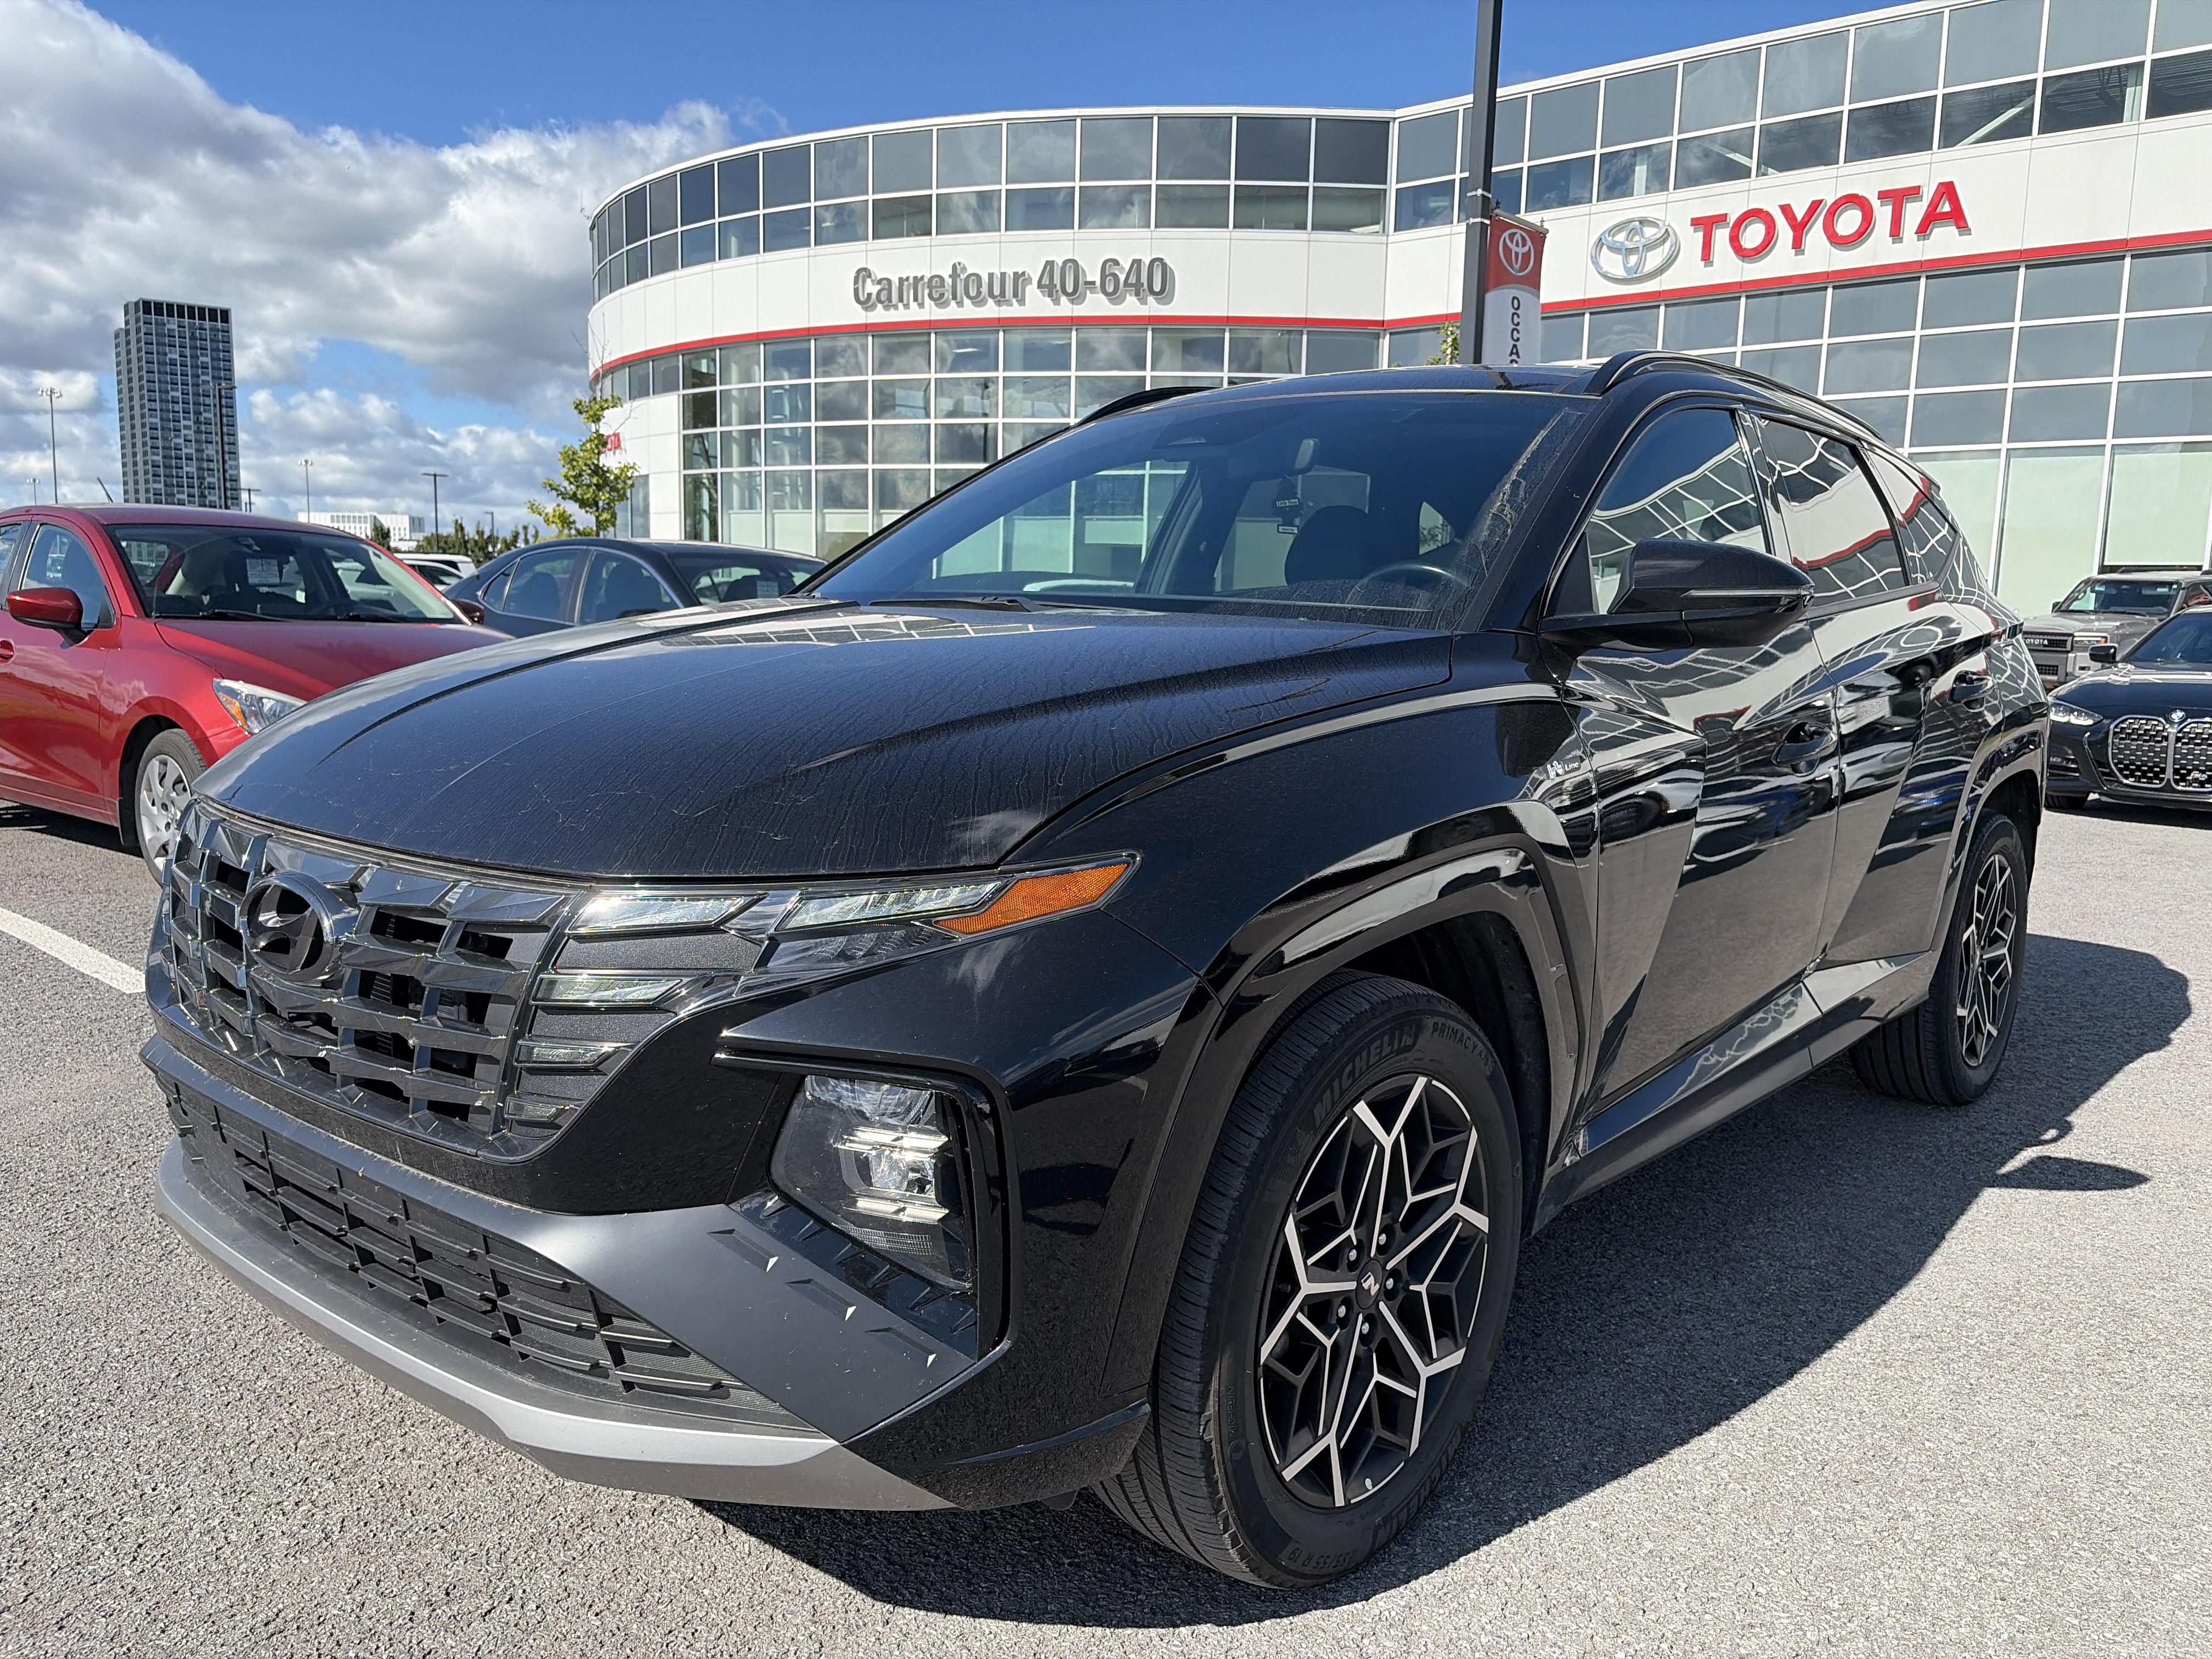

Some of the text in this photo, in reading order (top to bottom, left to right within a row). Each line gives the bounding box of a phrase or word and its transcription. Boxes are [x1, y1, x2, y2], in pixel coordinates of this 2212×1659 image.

[1690, 181, 1970, 264] TOYOTA
[853, 257, 1171, 307] Carrefour 40-640
[1565, 762, 1579, 771] Line
[1313, 1023, 1417, 1129] MICHELIN
[1431, 1021, 1479, 1054] PRIMACY
